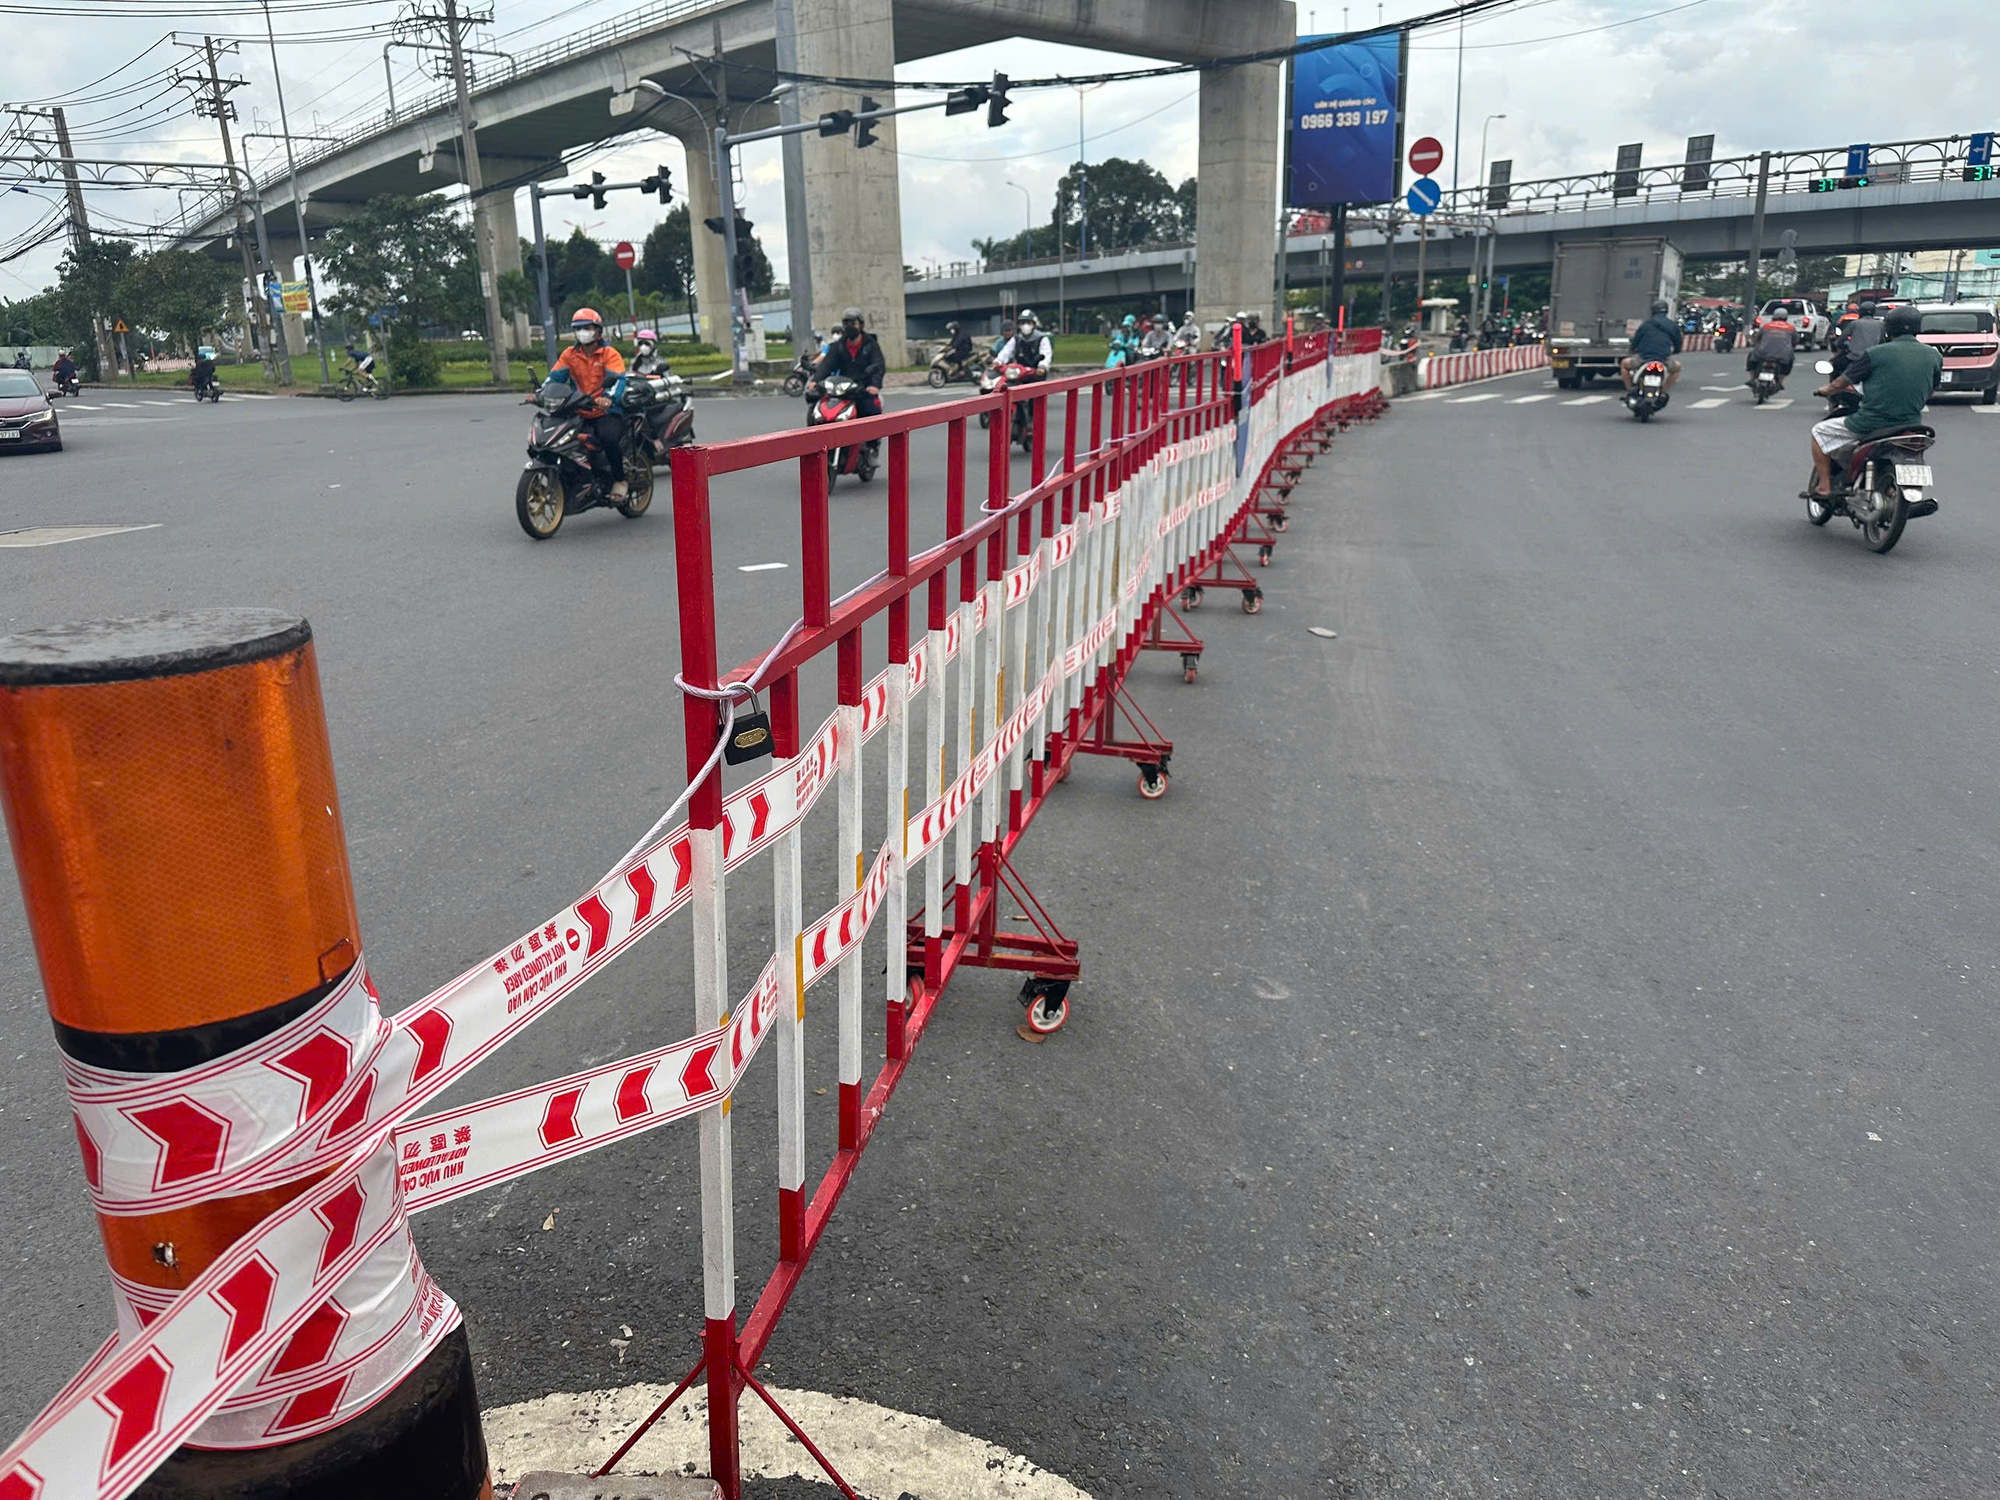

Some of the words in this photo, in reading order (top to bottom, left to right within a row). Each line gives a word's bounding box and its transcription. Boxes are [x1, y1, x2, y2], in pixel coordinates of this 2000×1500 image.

[1301, 113, 1334, 130] 0966
[1336, 111, 1361, 127] 339
[1365, 109, 1389, 125] 197
[1974, 165, 1992, 181] 37
[1818, 178, 1835, 193] 37
[550, 941, 566, 960] NOT
[522, 950, 551, 982] ALLOWED
[553, 960, 568, 981] KHU
[503, 970, 522, 994] AREA
[507, 993, 522, 1014] VÀO
[443, 1161, 464, 1179] KHU
